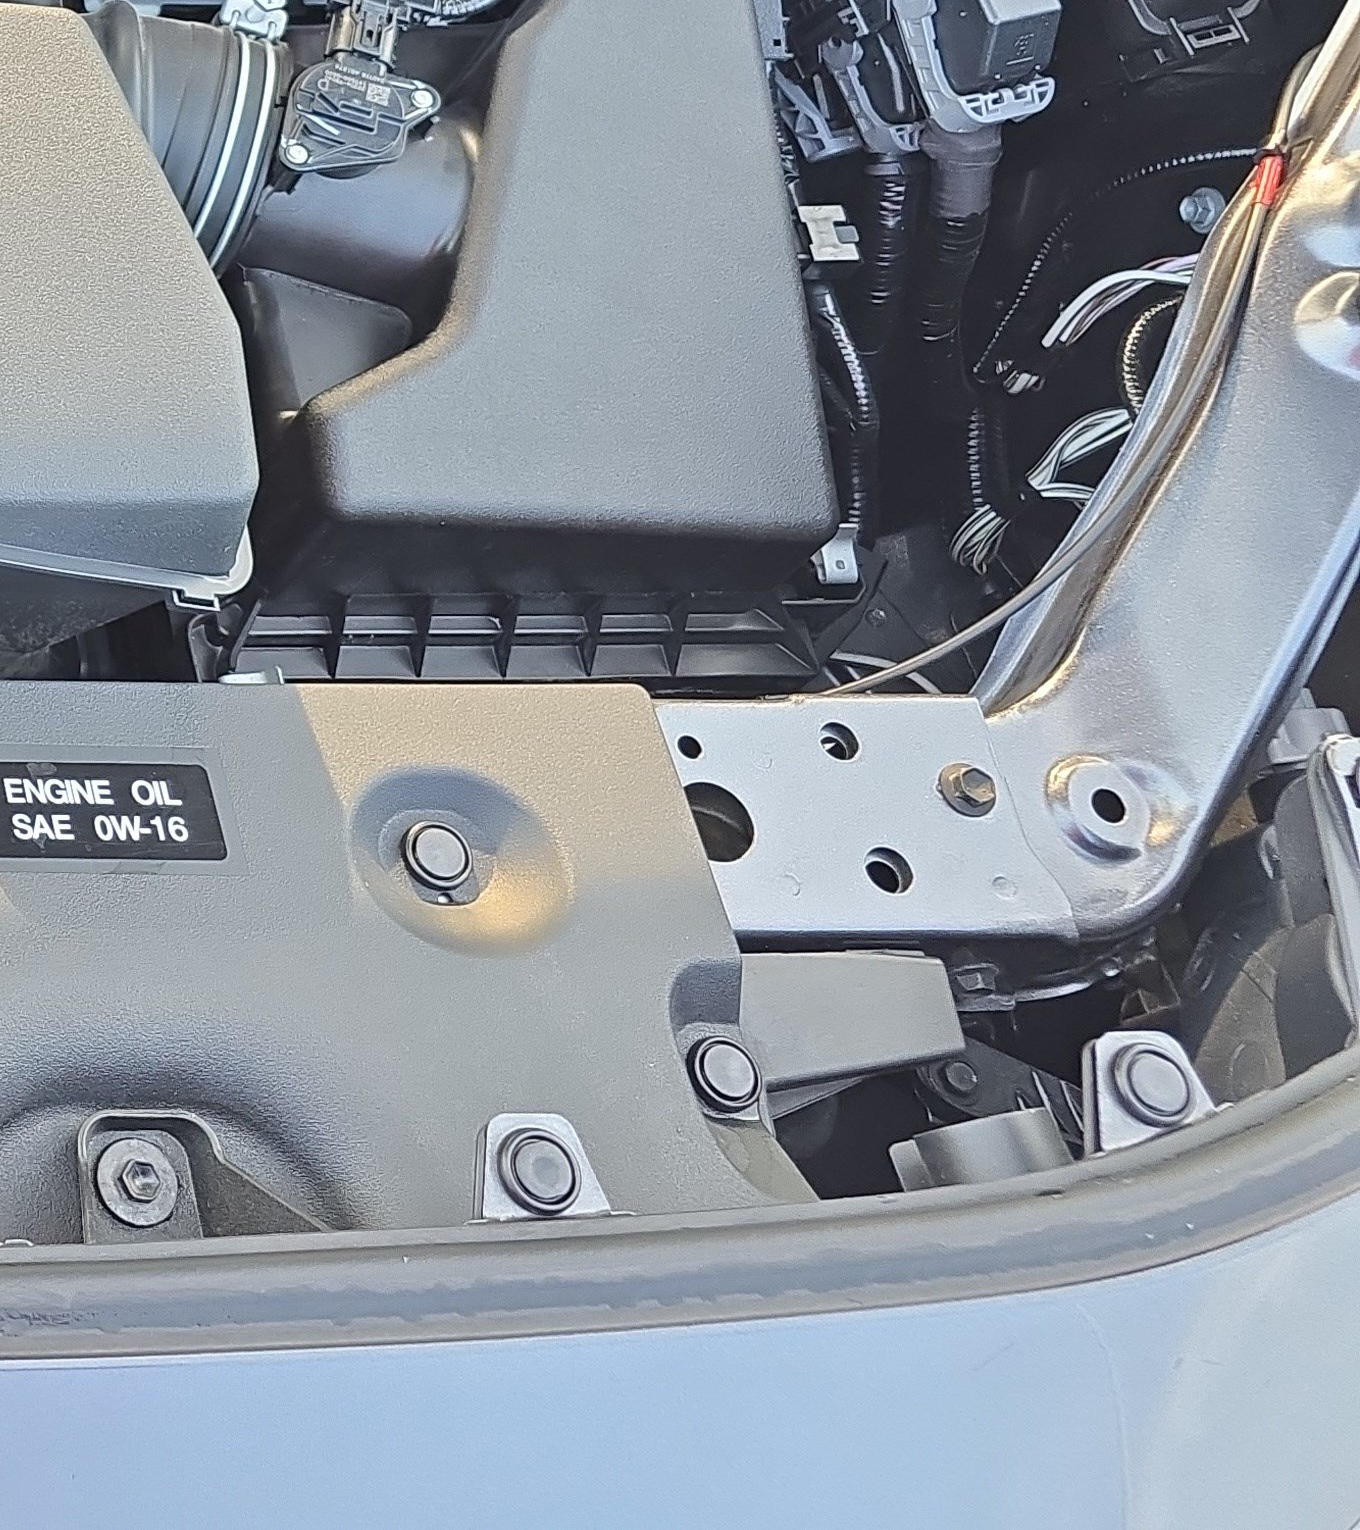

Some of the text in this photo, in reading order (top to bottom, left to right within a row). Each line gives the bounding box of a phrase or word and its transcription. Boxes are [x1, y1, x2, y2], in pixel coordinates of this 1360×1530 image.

[3, 777, 182, 807] ENGINE OIL
[12, 814, 189, 843] SAE 0W-16
